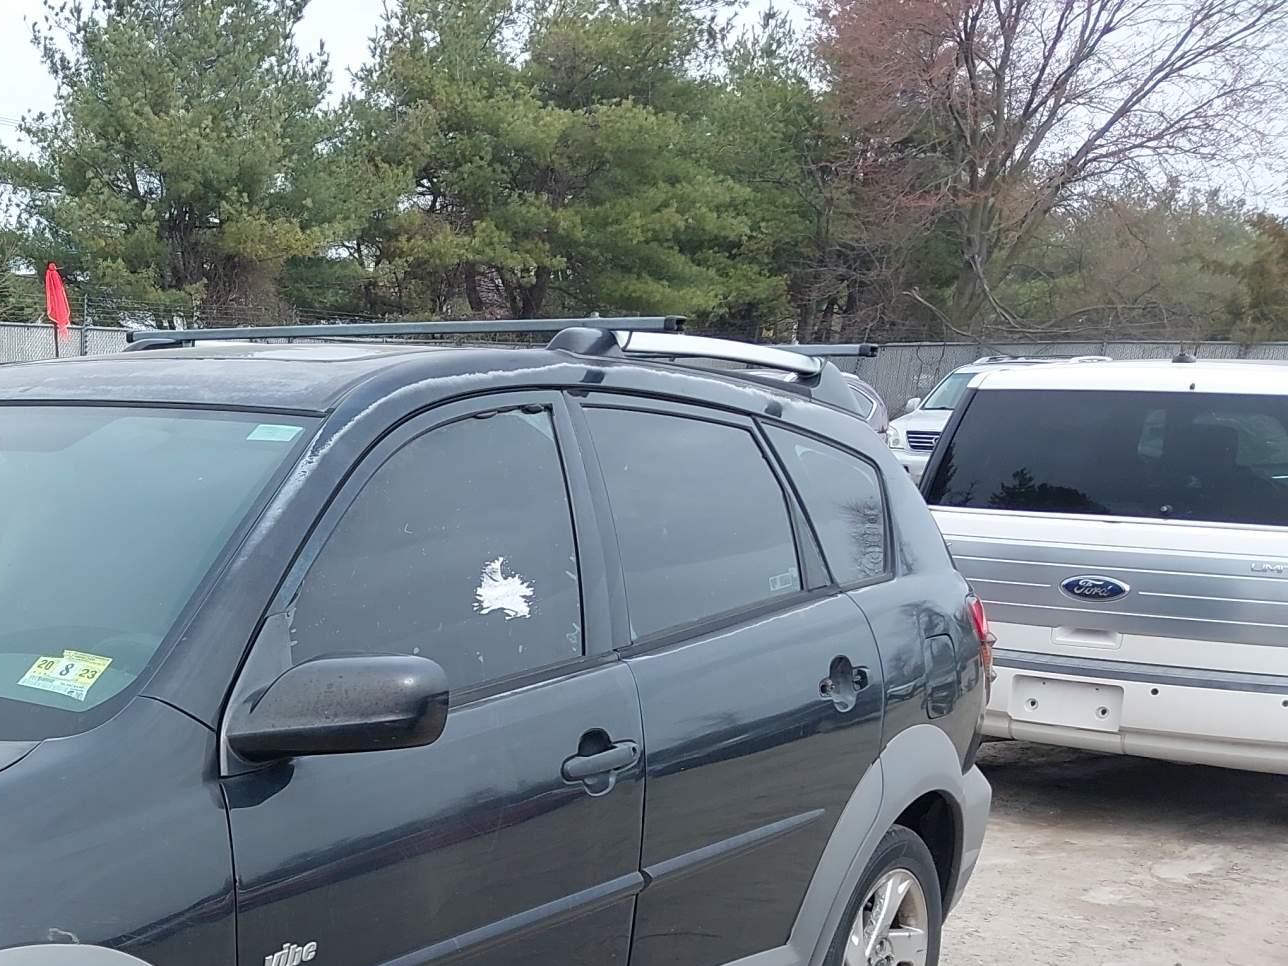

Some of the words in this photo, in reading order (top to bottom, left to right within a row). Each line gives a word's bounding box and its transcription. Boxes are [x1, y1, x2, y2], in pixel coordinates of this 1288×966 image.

[1073, 579, 1113, 597] Ford
[37, 660, 54, 670] 20
[59, 663, 74, 676] 8
[78, 669, 97, 679] 23
